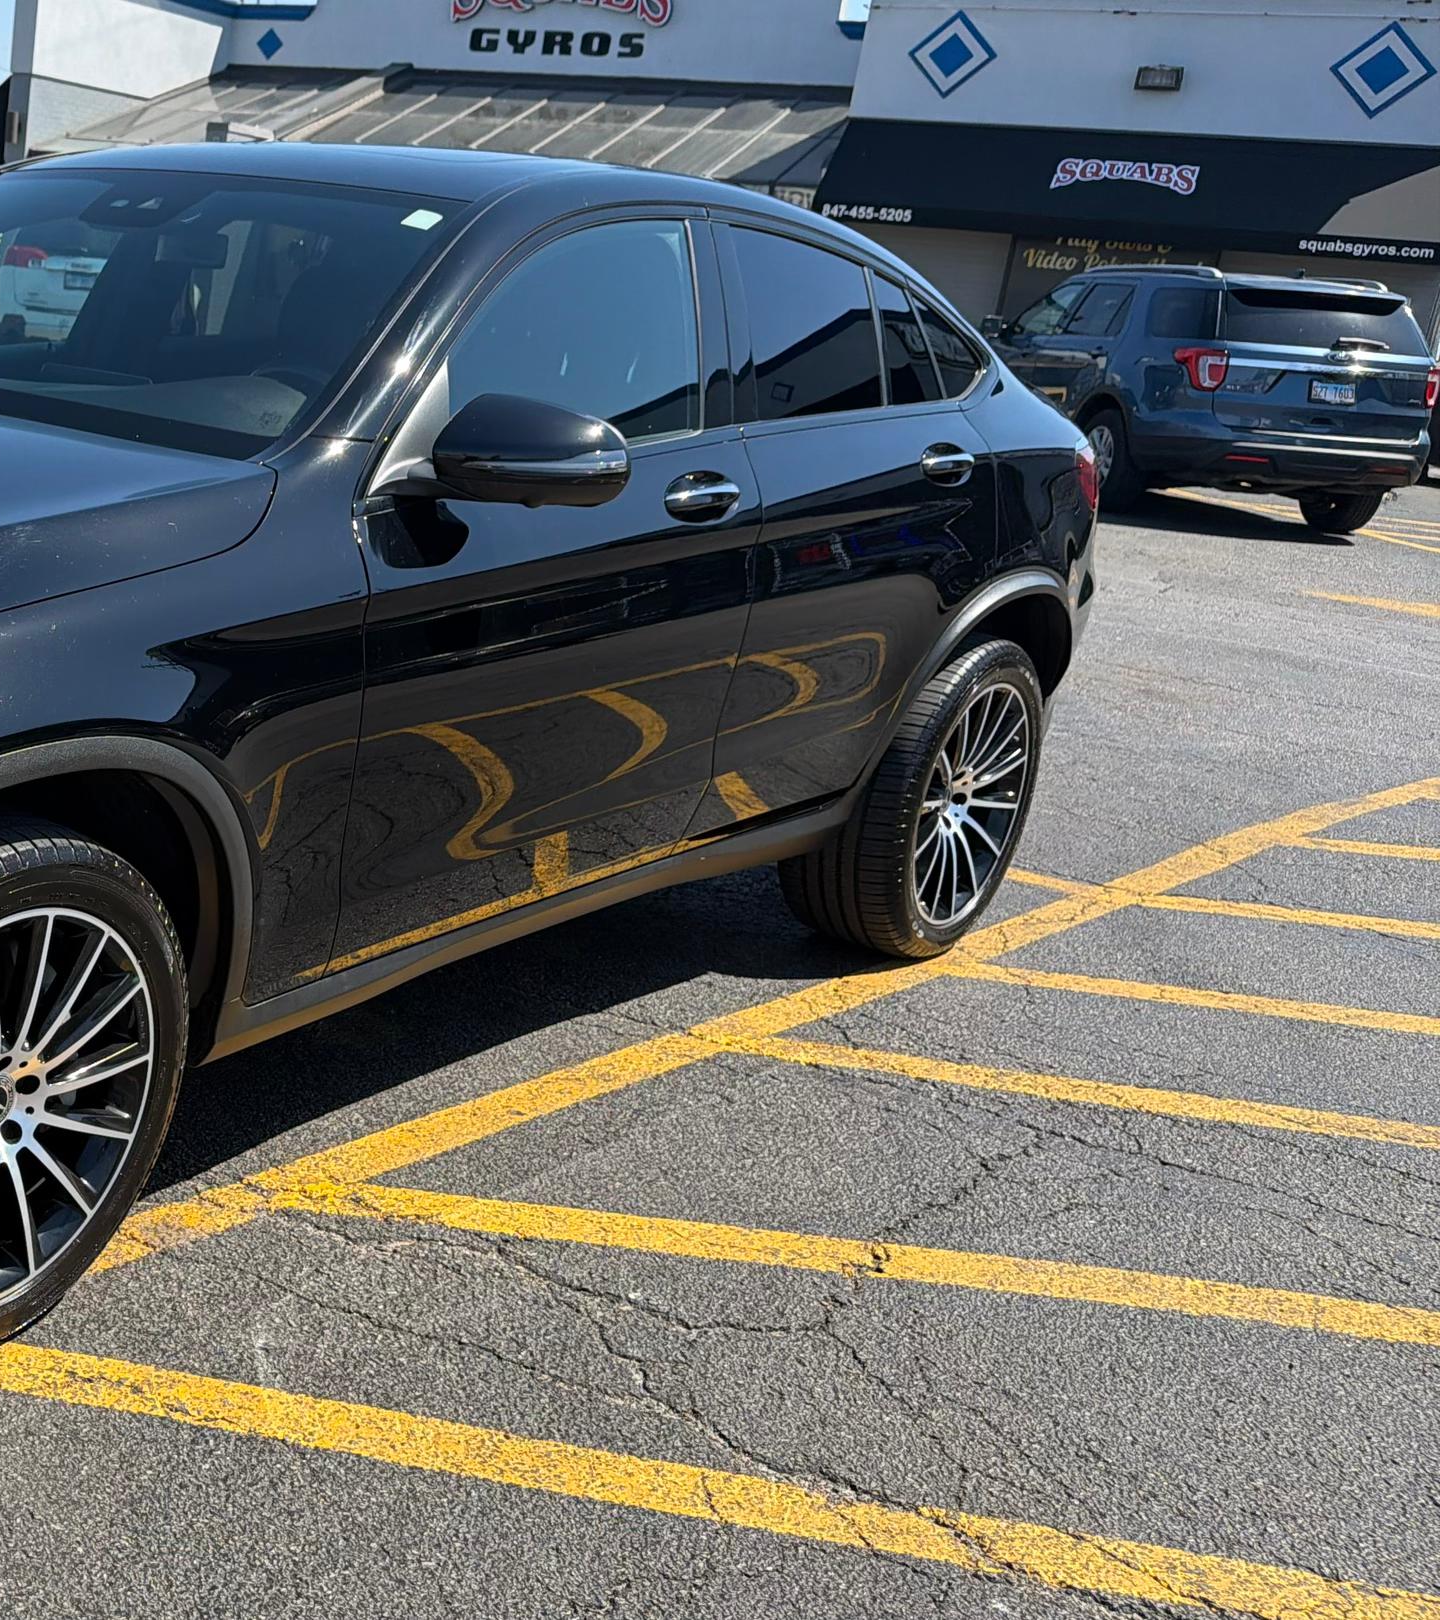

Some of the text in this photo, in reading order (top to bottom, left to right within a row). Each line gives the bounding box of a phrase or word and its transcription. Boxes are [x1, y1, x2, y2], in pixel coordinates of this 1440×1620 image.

[469, 28, 645, 58] GYROS
[1050, 158, 1200, 195] SQUABS
[822, 203, 912, 222] 847-455-5205
[1024, 248, 1079, 271] Video
[1299, 240, 1434, 258] squabsgyros.com
